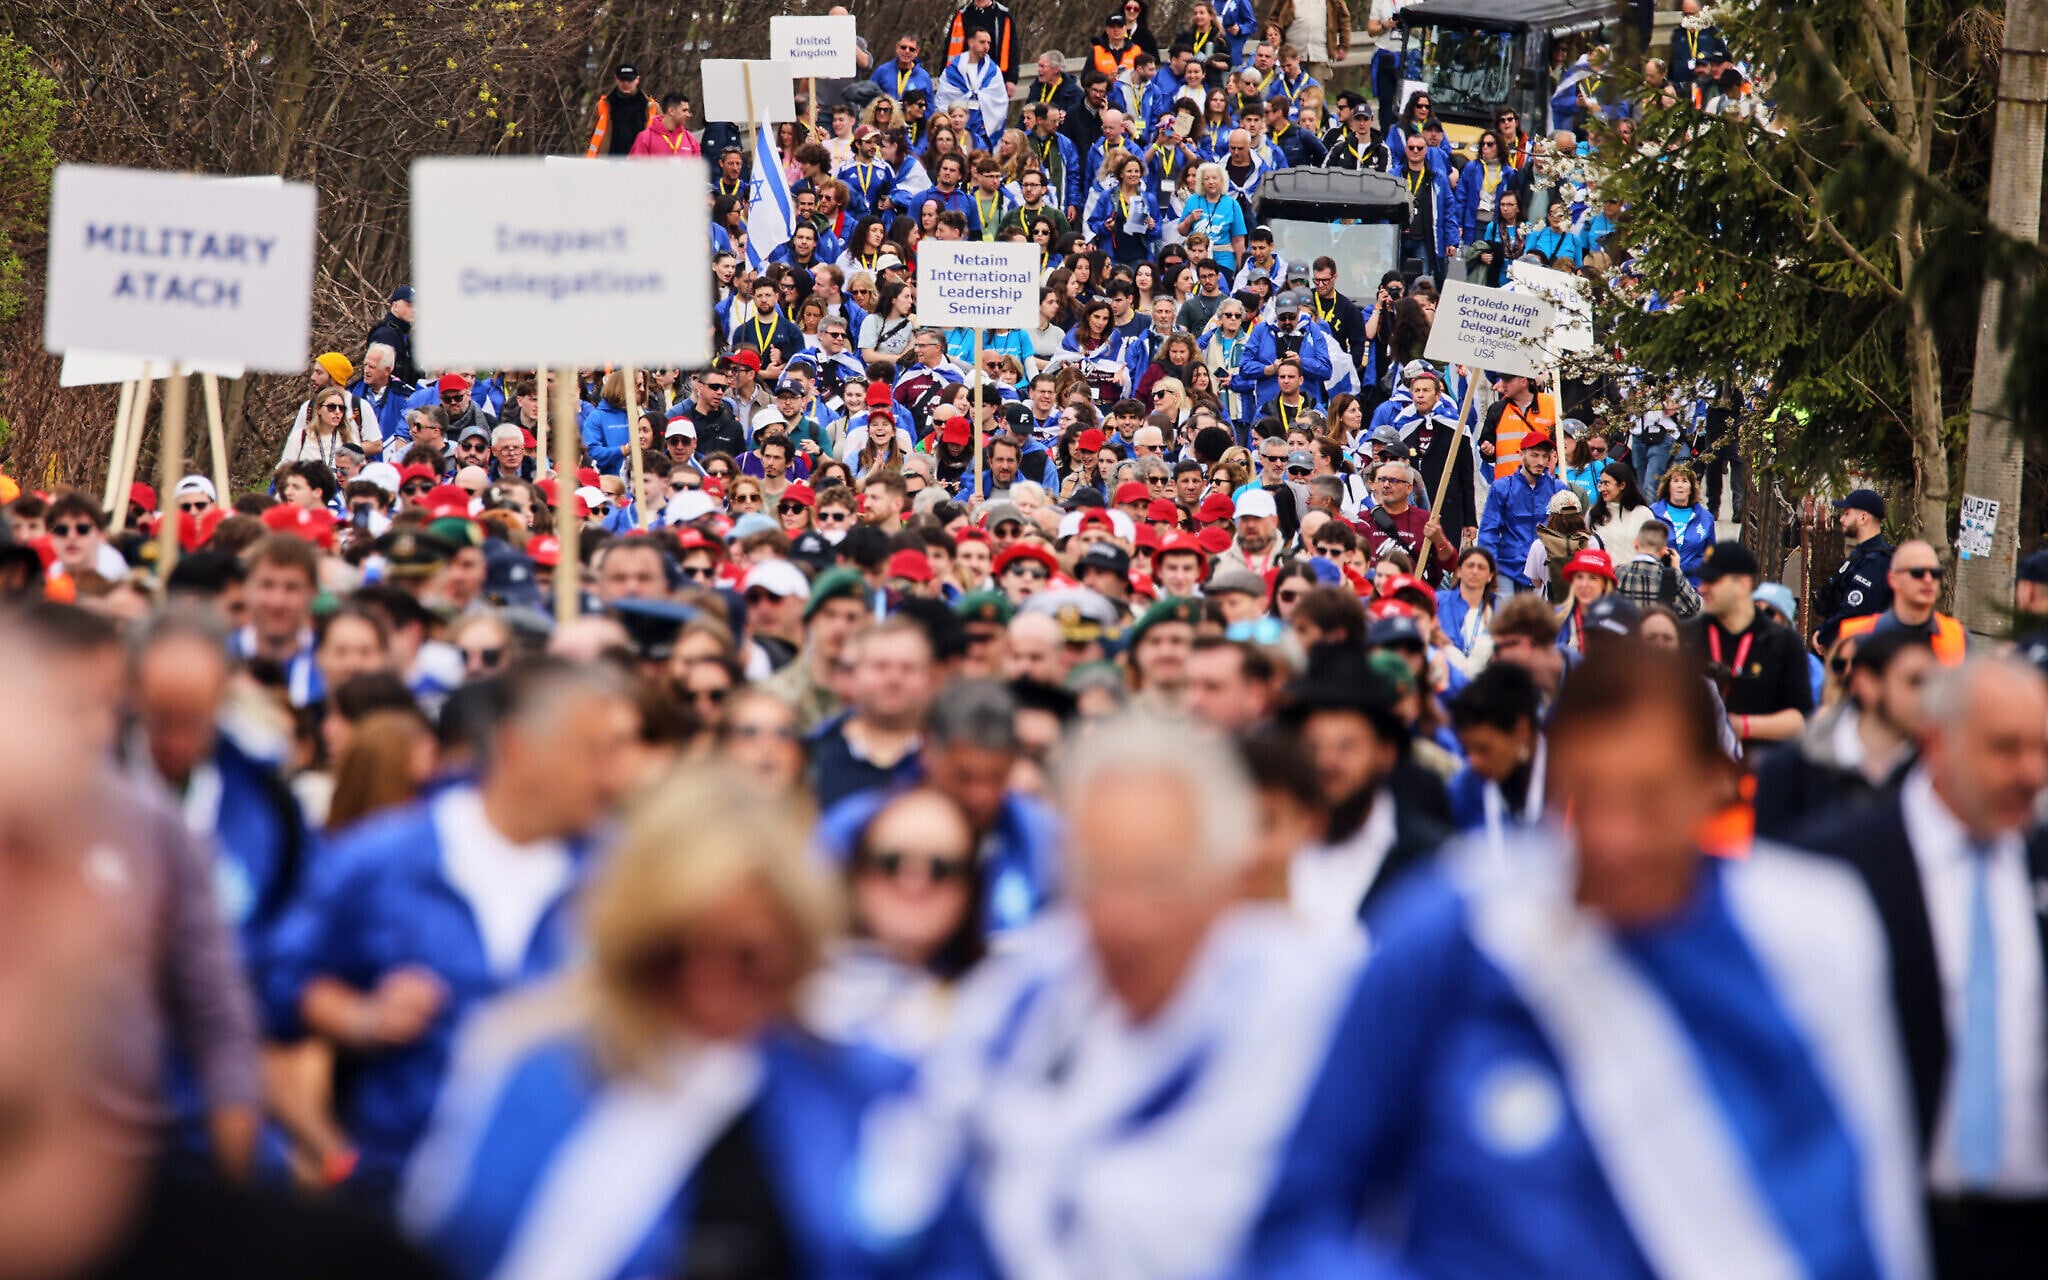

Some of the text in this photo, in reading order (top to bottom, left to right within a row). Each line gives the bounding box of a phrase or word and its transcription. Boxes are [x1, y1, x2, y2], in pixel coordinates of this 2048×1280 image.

[796, 36, 831, 45] United
[790, 48, 837, 59] Kingdom
[85, 221, 276, 264] MILITARY
[495, 223, 627, 257] Impact
[953, 254, 1008, 266] Netaim
[461, 268, 664, 301] Delegation
[930, 269, 1031, 283] International
[113, 271, 241, 309] ATACH
[939, 285, 1022, 302] Leadership
[949, 302, 1012, 315] Seminar
[1457, 294, 1510, 311] deToledo
[1512, 304, 1539, 317] High
[1459, 306, 1530, 328] School Adult
[1460, 319, 1522, 339] Delegation
[1458, 332, 1518, 351] Los Angeles
[1474, 347, 1495, 359] USA
